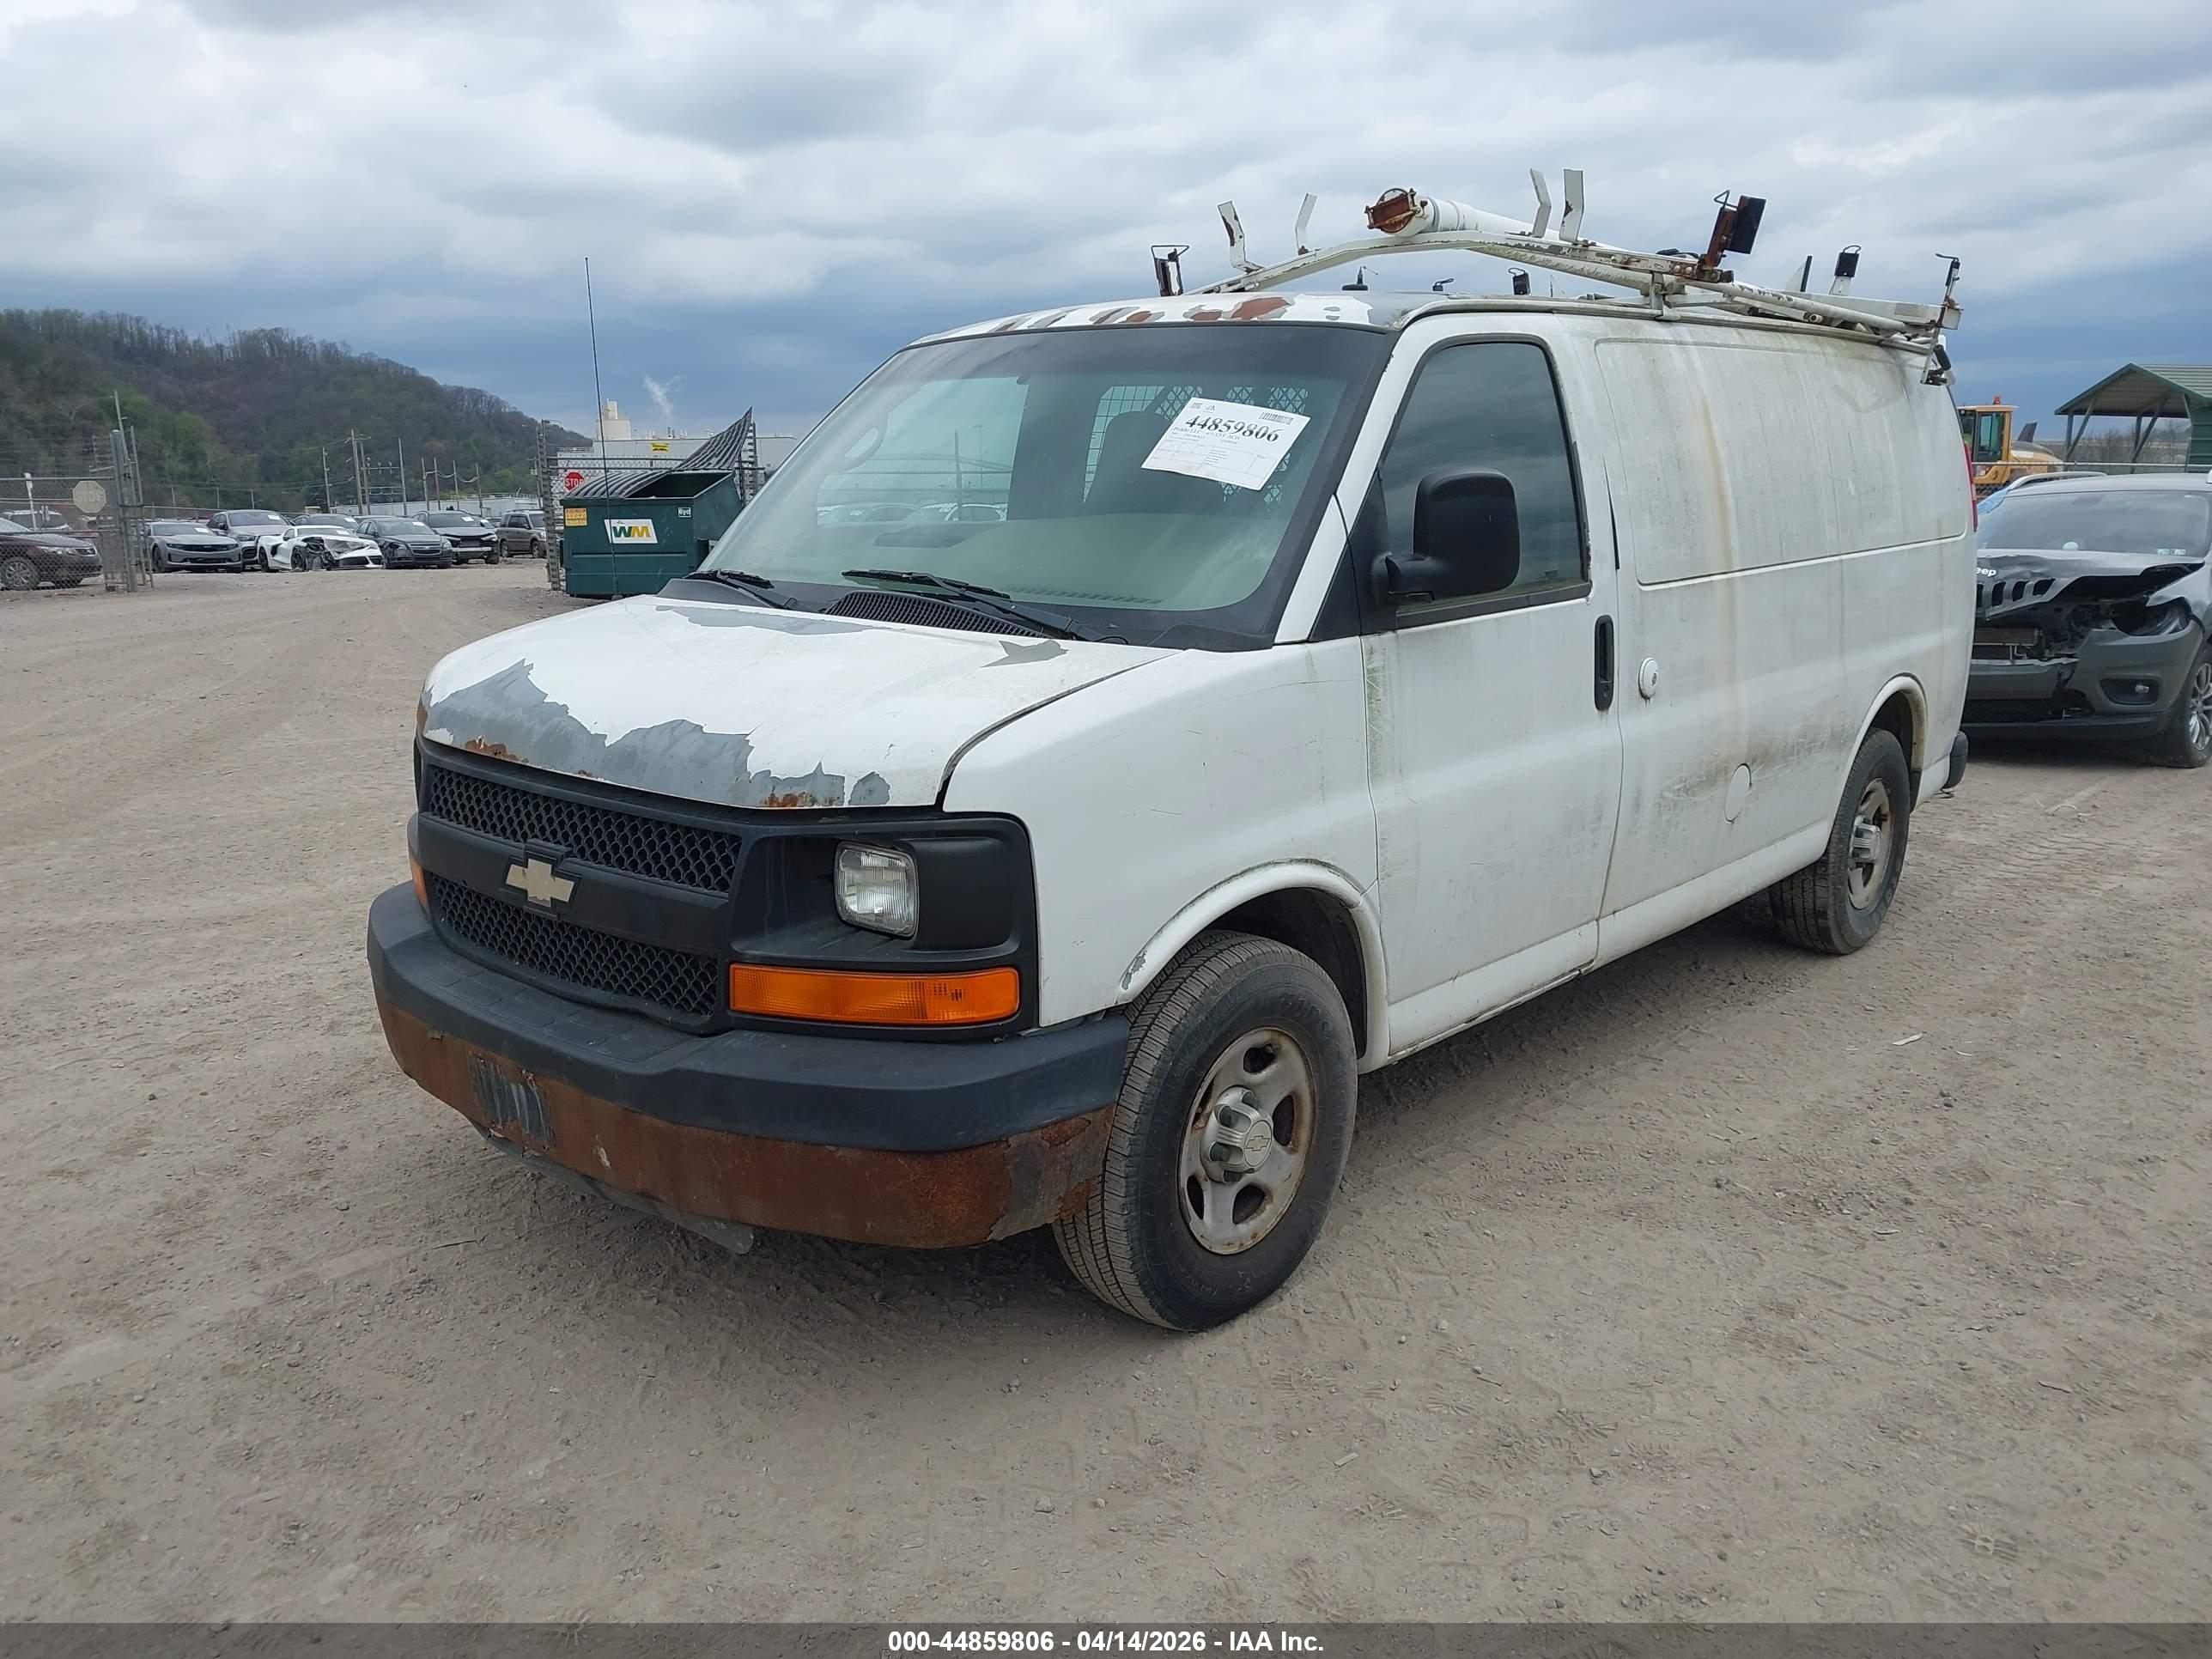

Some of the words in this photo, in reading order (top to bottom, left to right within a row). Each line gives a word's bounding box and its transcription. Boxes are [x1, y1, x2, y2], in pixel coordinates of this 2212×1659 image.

[1186, 415, 1284, 442] 44859806
[565, 477, 584, 488] STOP
[612, 526, 652, 538] WM
[1975, 567, 1996, 577] eep
